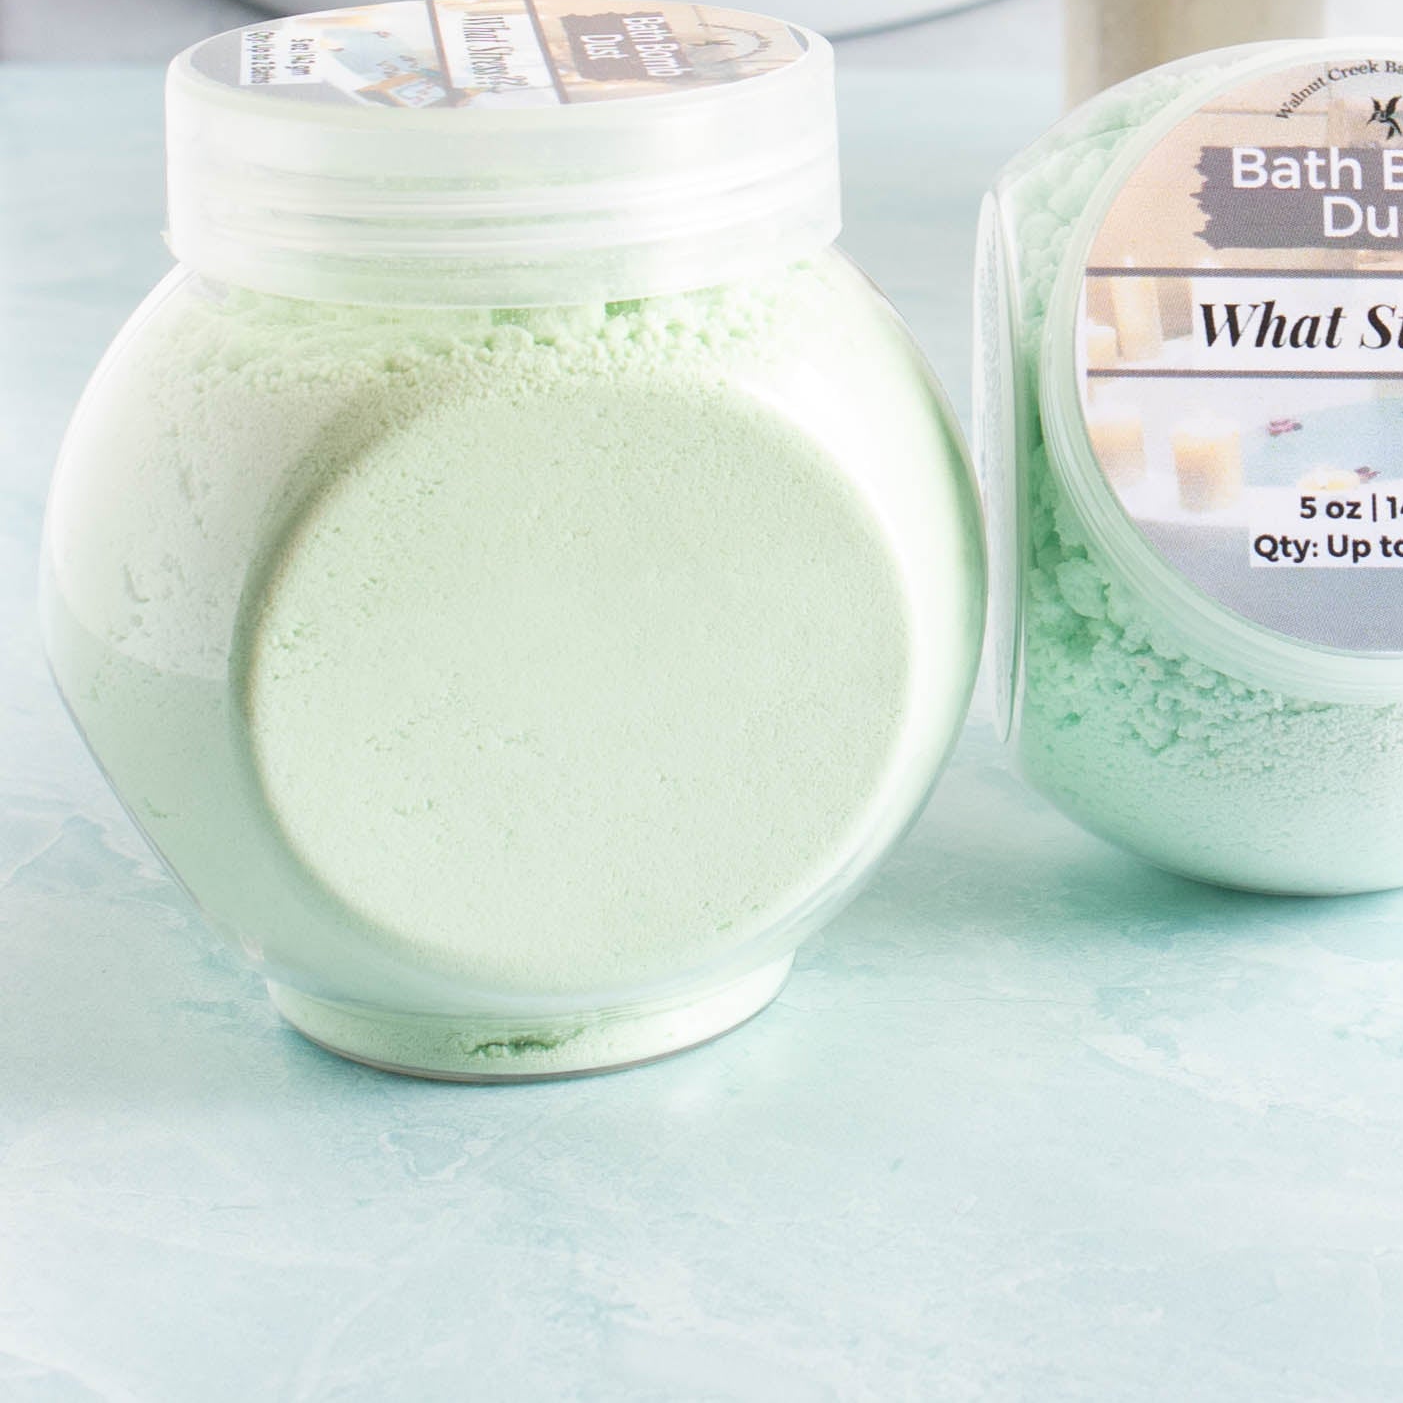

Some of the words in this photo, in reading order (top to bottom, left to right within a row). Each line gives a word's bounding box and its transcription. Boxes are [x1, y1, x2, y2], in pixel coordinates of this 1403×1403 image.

[463, 17, 511, 42] What
[622, 17, 673, 42] Bath
[580, 34, 629, 60] Dust
[635, 43, 694, 77] Bomb
[1275, 77, 1328, 120] Walnut
[1327, 60, 1379, 82] Creek
[1232, 147, 1362, 190] Bath
[1199, 299, 1347, 348] What
[1300, 496, 1317, 519] 5
[1325, 500, 1362, 519] oz
[1254, 534, 1318, 563] Qty:
[1327, 535, 1371, 563] Up
